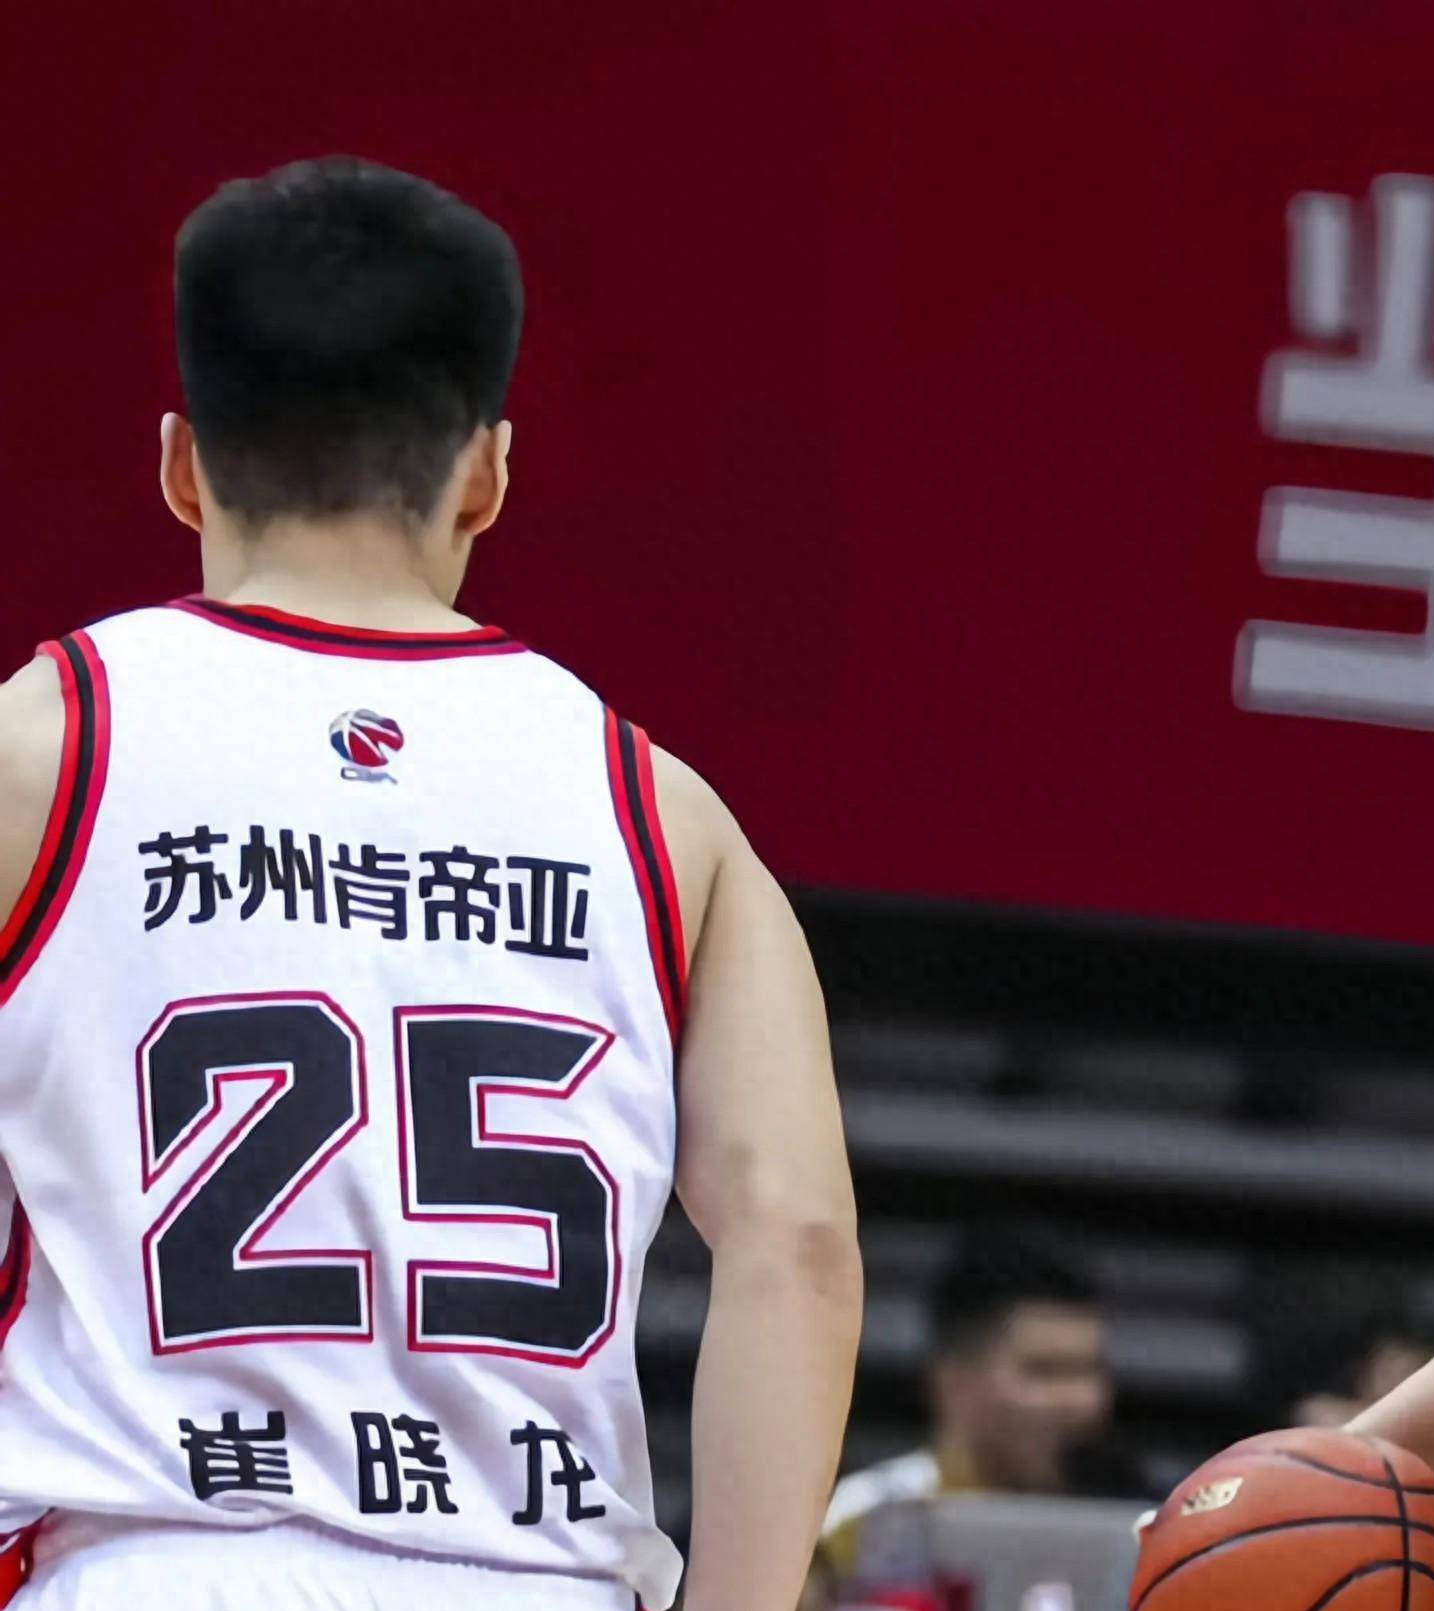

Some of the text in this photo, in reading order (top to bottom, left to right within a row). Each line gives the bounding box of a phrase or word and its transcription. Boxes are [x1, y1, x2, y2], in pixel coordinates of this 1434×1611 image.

[138, 825, 591, 961] 苏州肯帝亚
[136, 991, 621, 1369] 25
